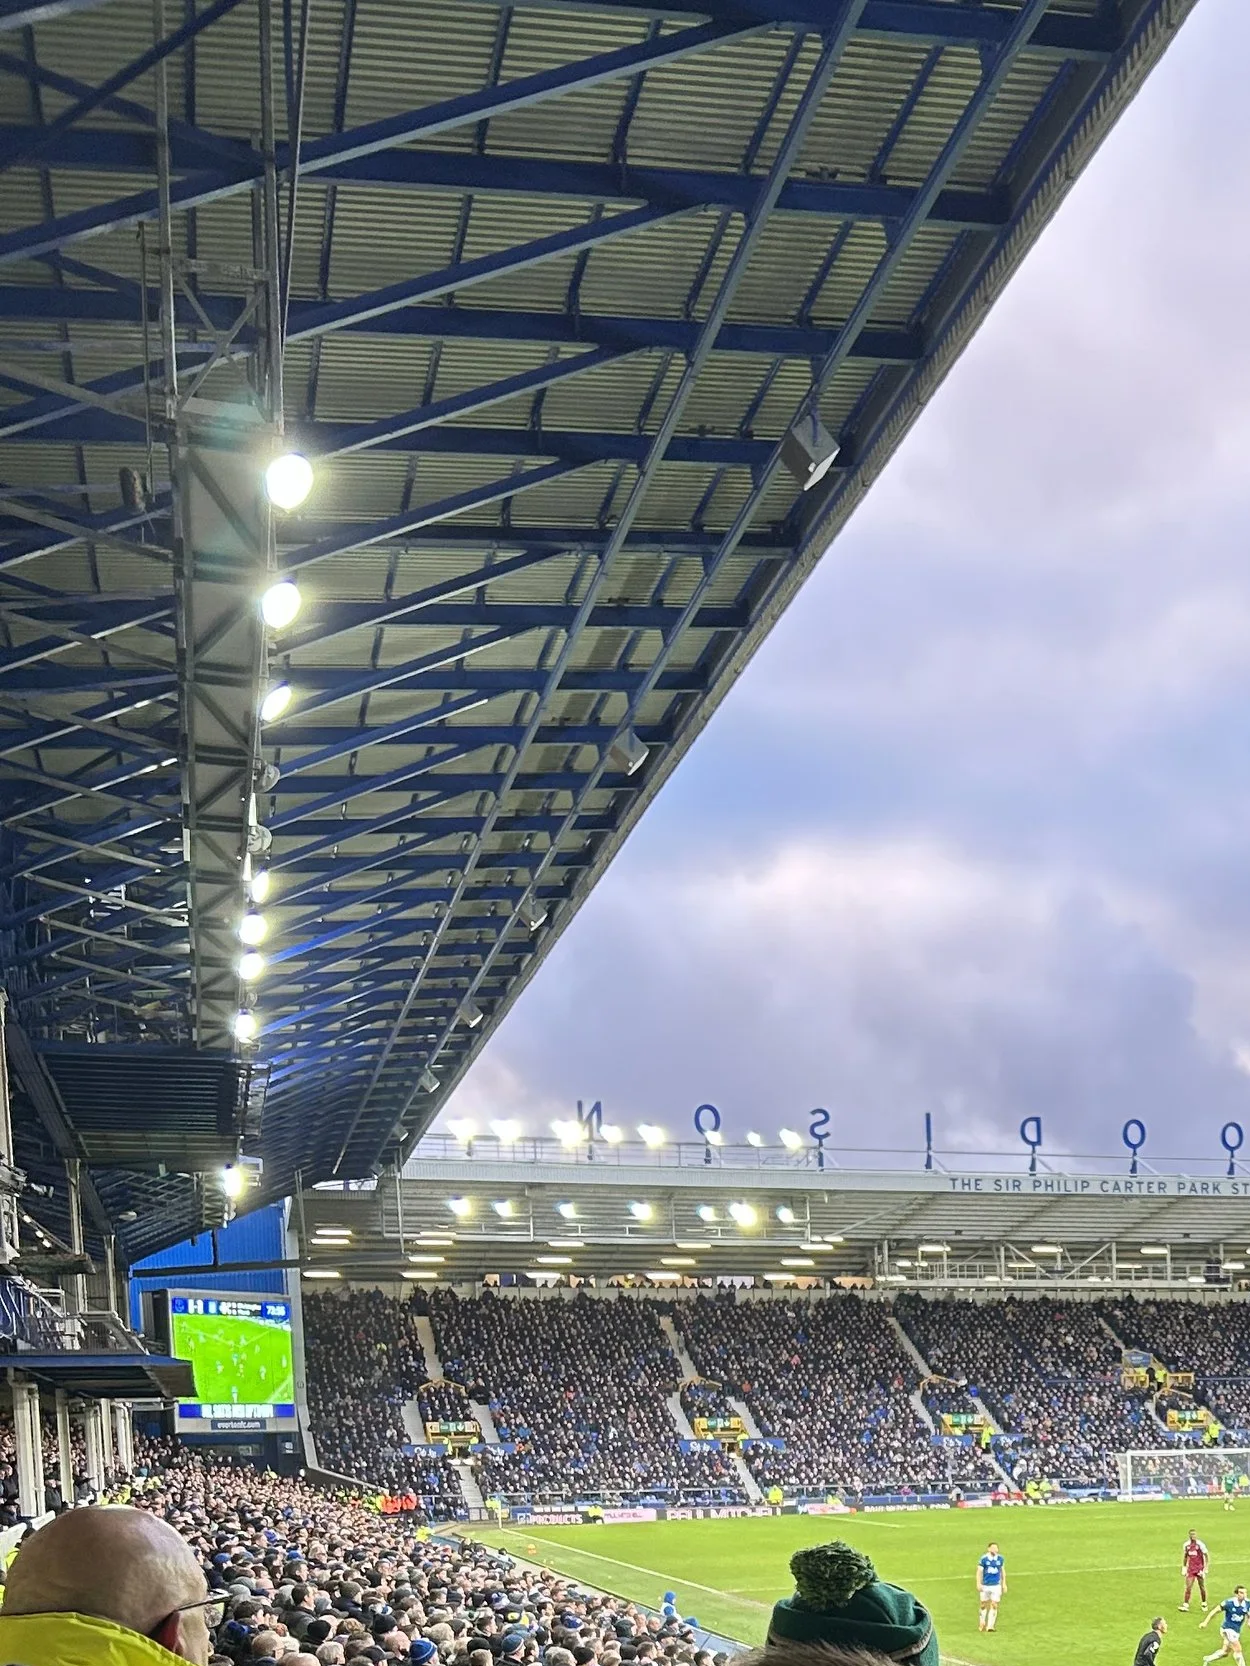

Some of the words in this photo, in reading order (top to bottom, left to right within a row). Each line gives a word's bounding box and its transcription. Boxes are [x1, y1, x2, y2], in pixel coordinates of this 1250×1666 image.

[950, 1178, 983, 1191] THE
[993, 1179, 1022, 1192] SIR
[1032, 1180, 1090, 1193] PHILIP
[1100, 1180, 1168, 1193] CARTER
[1177, 1182, 1222, 1194] PARK
